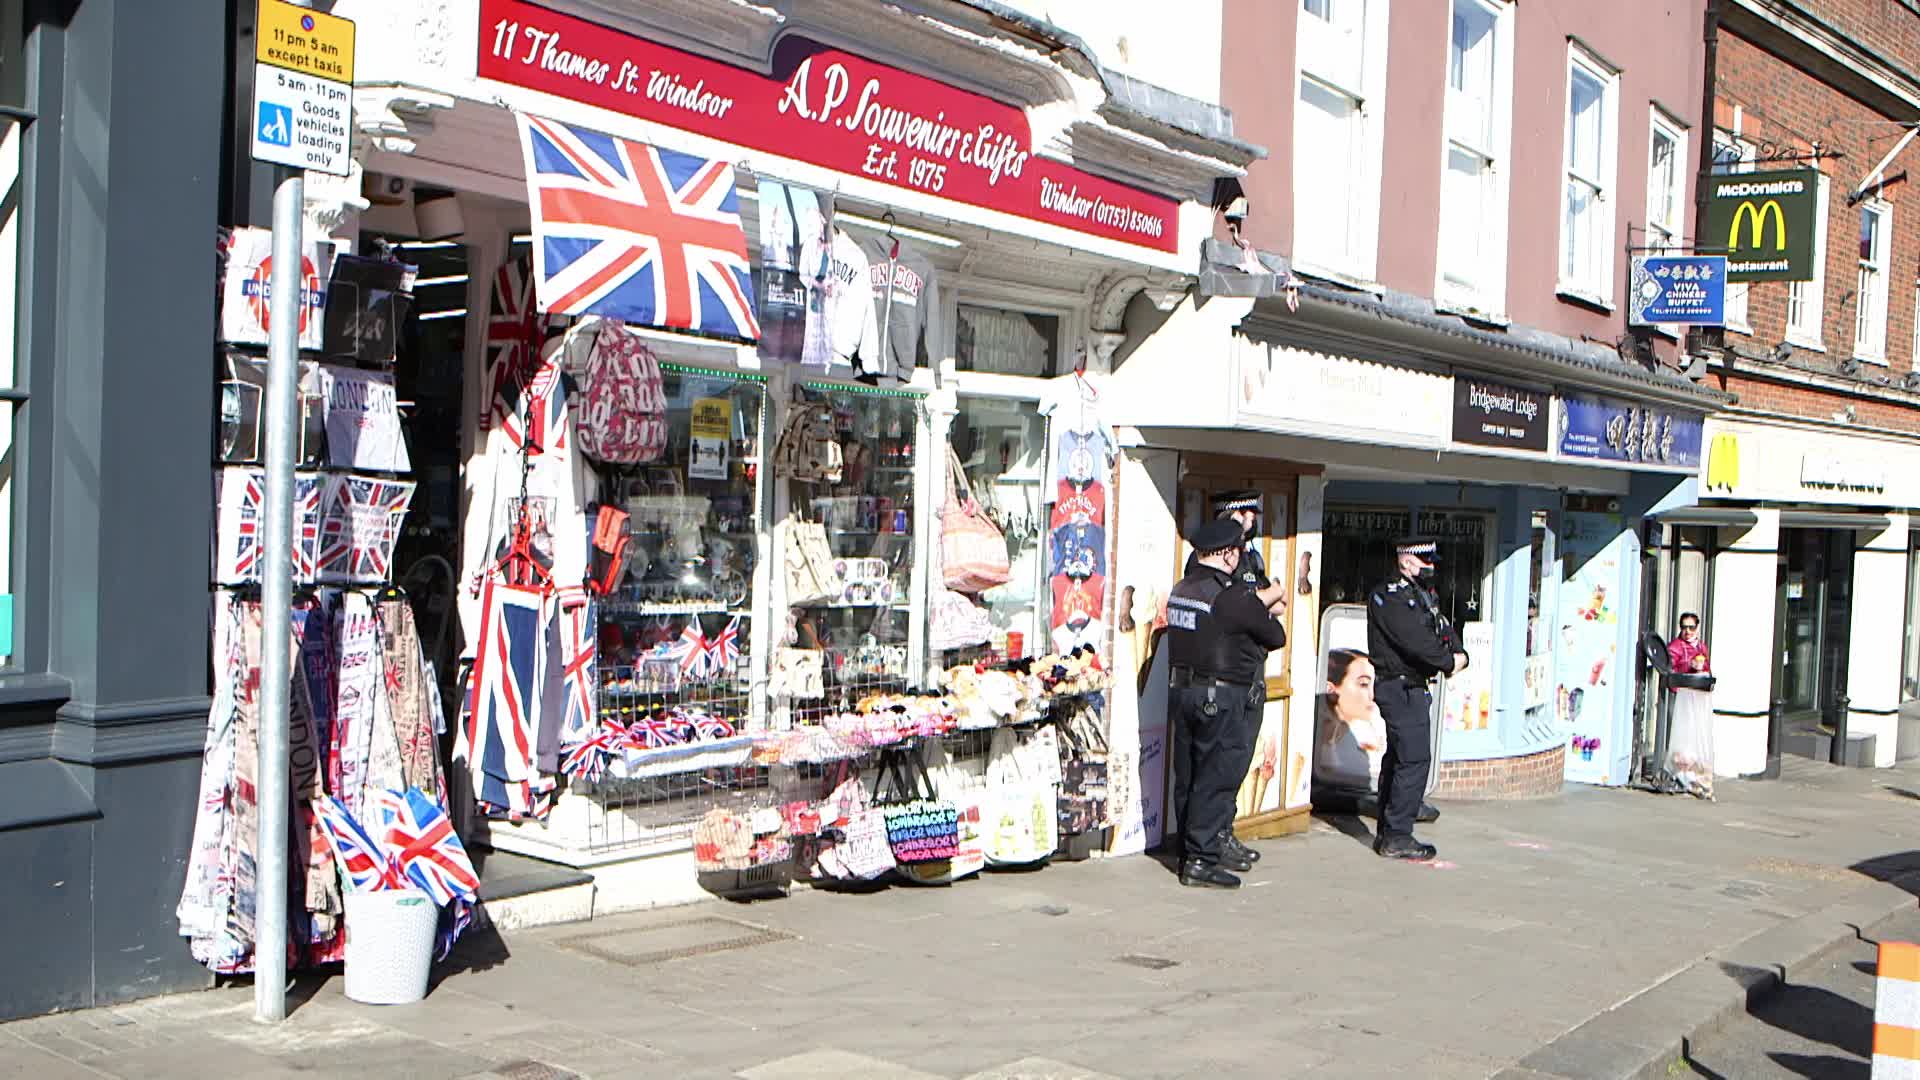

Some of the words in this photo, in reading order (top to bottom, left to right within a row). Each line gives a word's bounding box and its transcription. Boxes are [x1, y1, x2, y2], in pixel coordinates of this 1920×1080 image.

[274, 28, 284, 40] 11
[288, 34, 306, 47] pm
[311, 39, 318, 50] 5
[321, 44, 338, 56] am
[268, 47, 309, 67] except
[314, 58, 342, 75] taxis
[492, 19, 518, 60] 11
[522, 27, 610, 85] Thames
[611, 60, 639, 93] St.
[646, 70, 733, 119] Windsor
[277, 74, 285, 86] 5
[288, 80, 306, 92] am
[316, 83, 326, 96] 11
[329, 90, 346, 102] pm
[303, 101, 340, 120] Goods
[296, 117, 344, 136] vehicles
[846, 79, 961, 159] Souvenirs
[973, 124, 1028, 186] Gifts
[297, 132, 342, 153] loading
[306, 151, 332, 166] only
[861, 143, 898, 180] Est.
[908, 156, 947, 191] 1975
[1040, 176, 1093, 219] Windsor
[1091, 195, 1130, 233] (01753)
[1673, 282, 1700, 291] VIVA
[1667, 298, 1705, 307] BUFFET
[326, 380, 392, 416] LONDON
[1470, 384, 1514, 415] Bridgewater
[1515, 393, 1538, 421] Lodge
